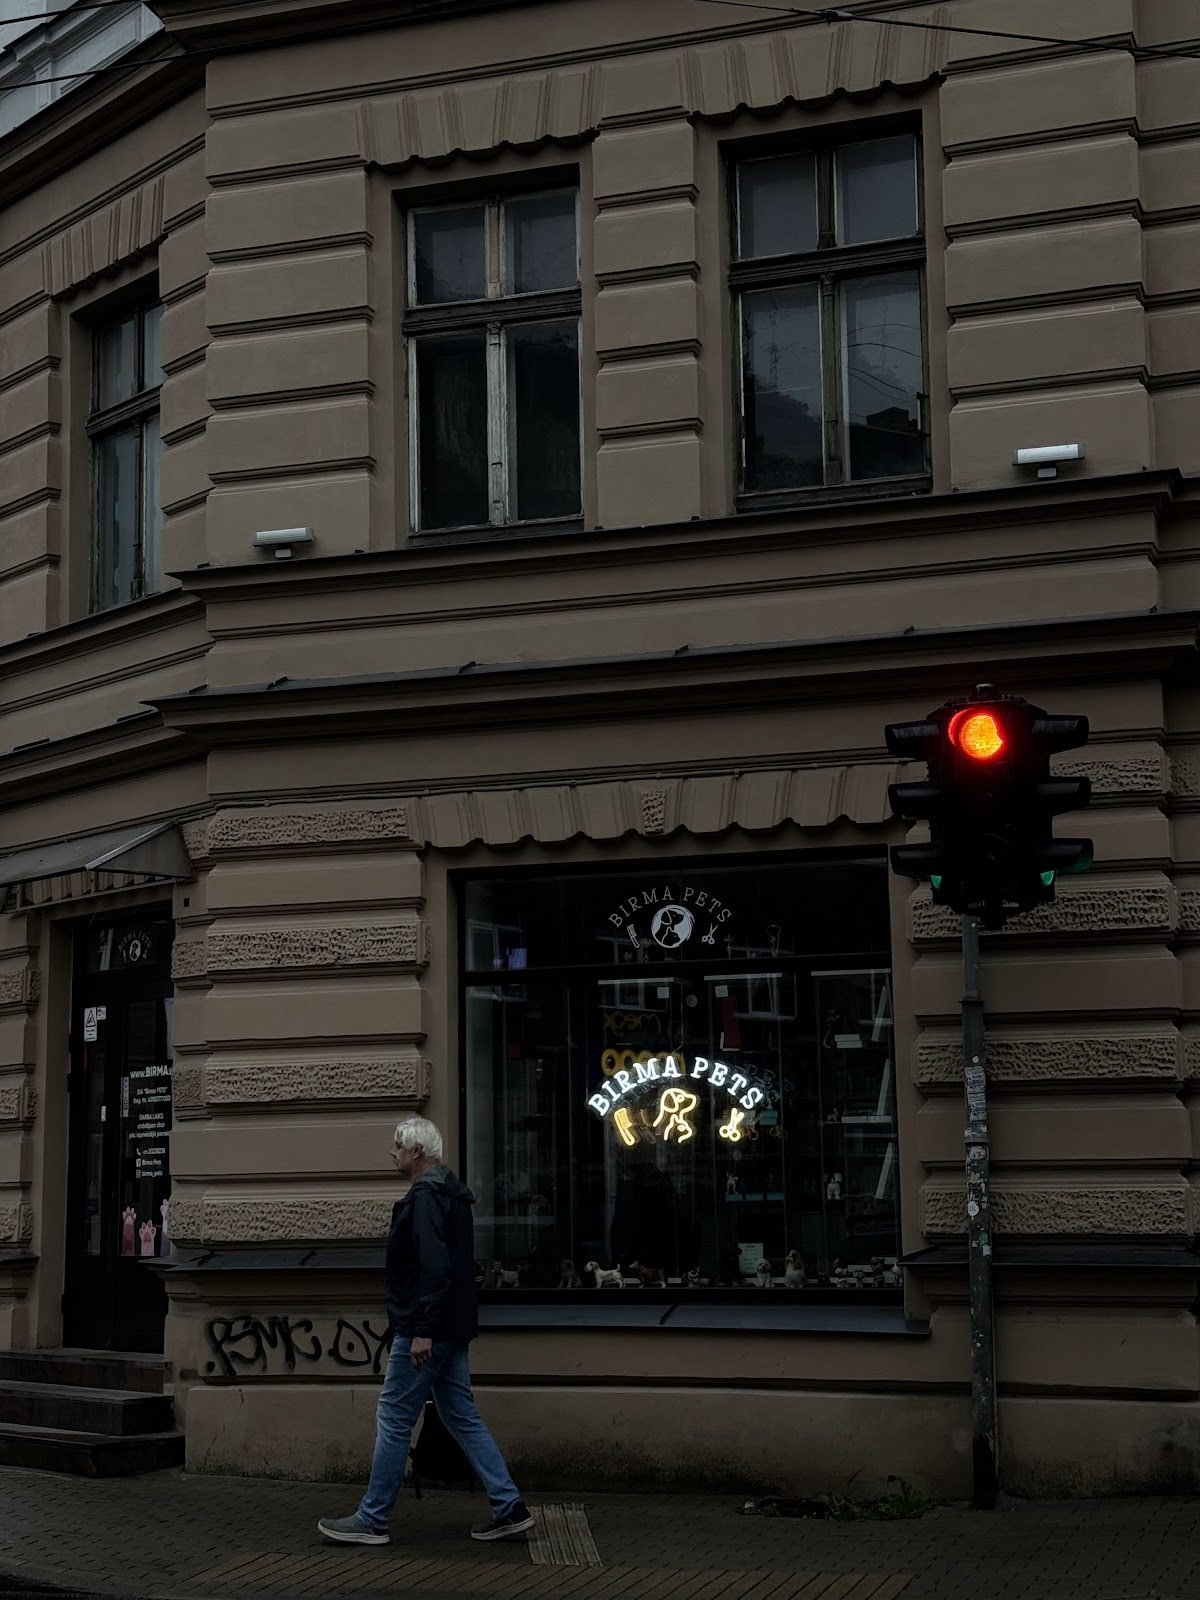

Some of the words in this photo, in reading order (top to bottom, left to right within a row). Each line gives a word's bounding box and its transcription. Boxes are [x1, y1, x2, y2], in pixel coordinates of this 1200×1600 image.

[608, 885, 674, 928] BIRMA
[682, 886, 732, 922] PETS
[588, 1055, 682, 1117] BIRMA
[690, 1056, 764, 1109] PETS
